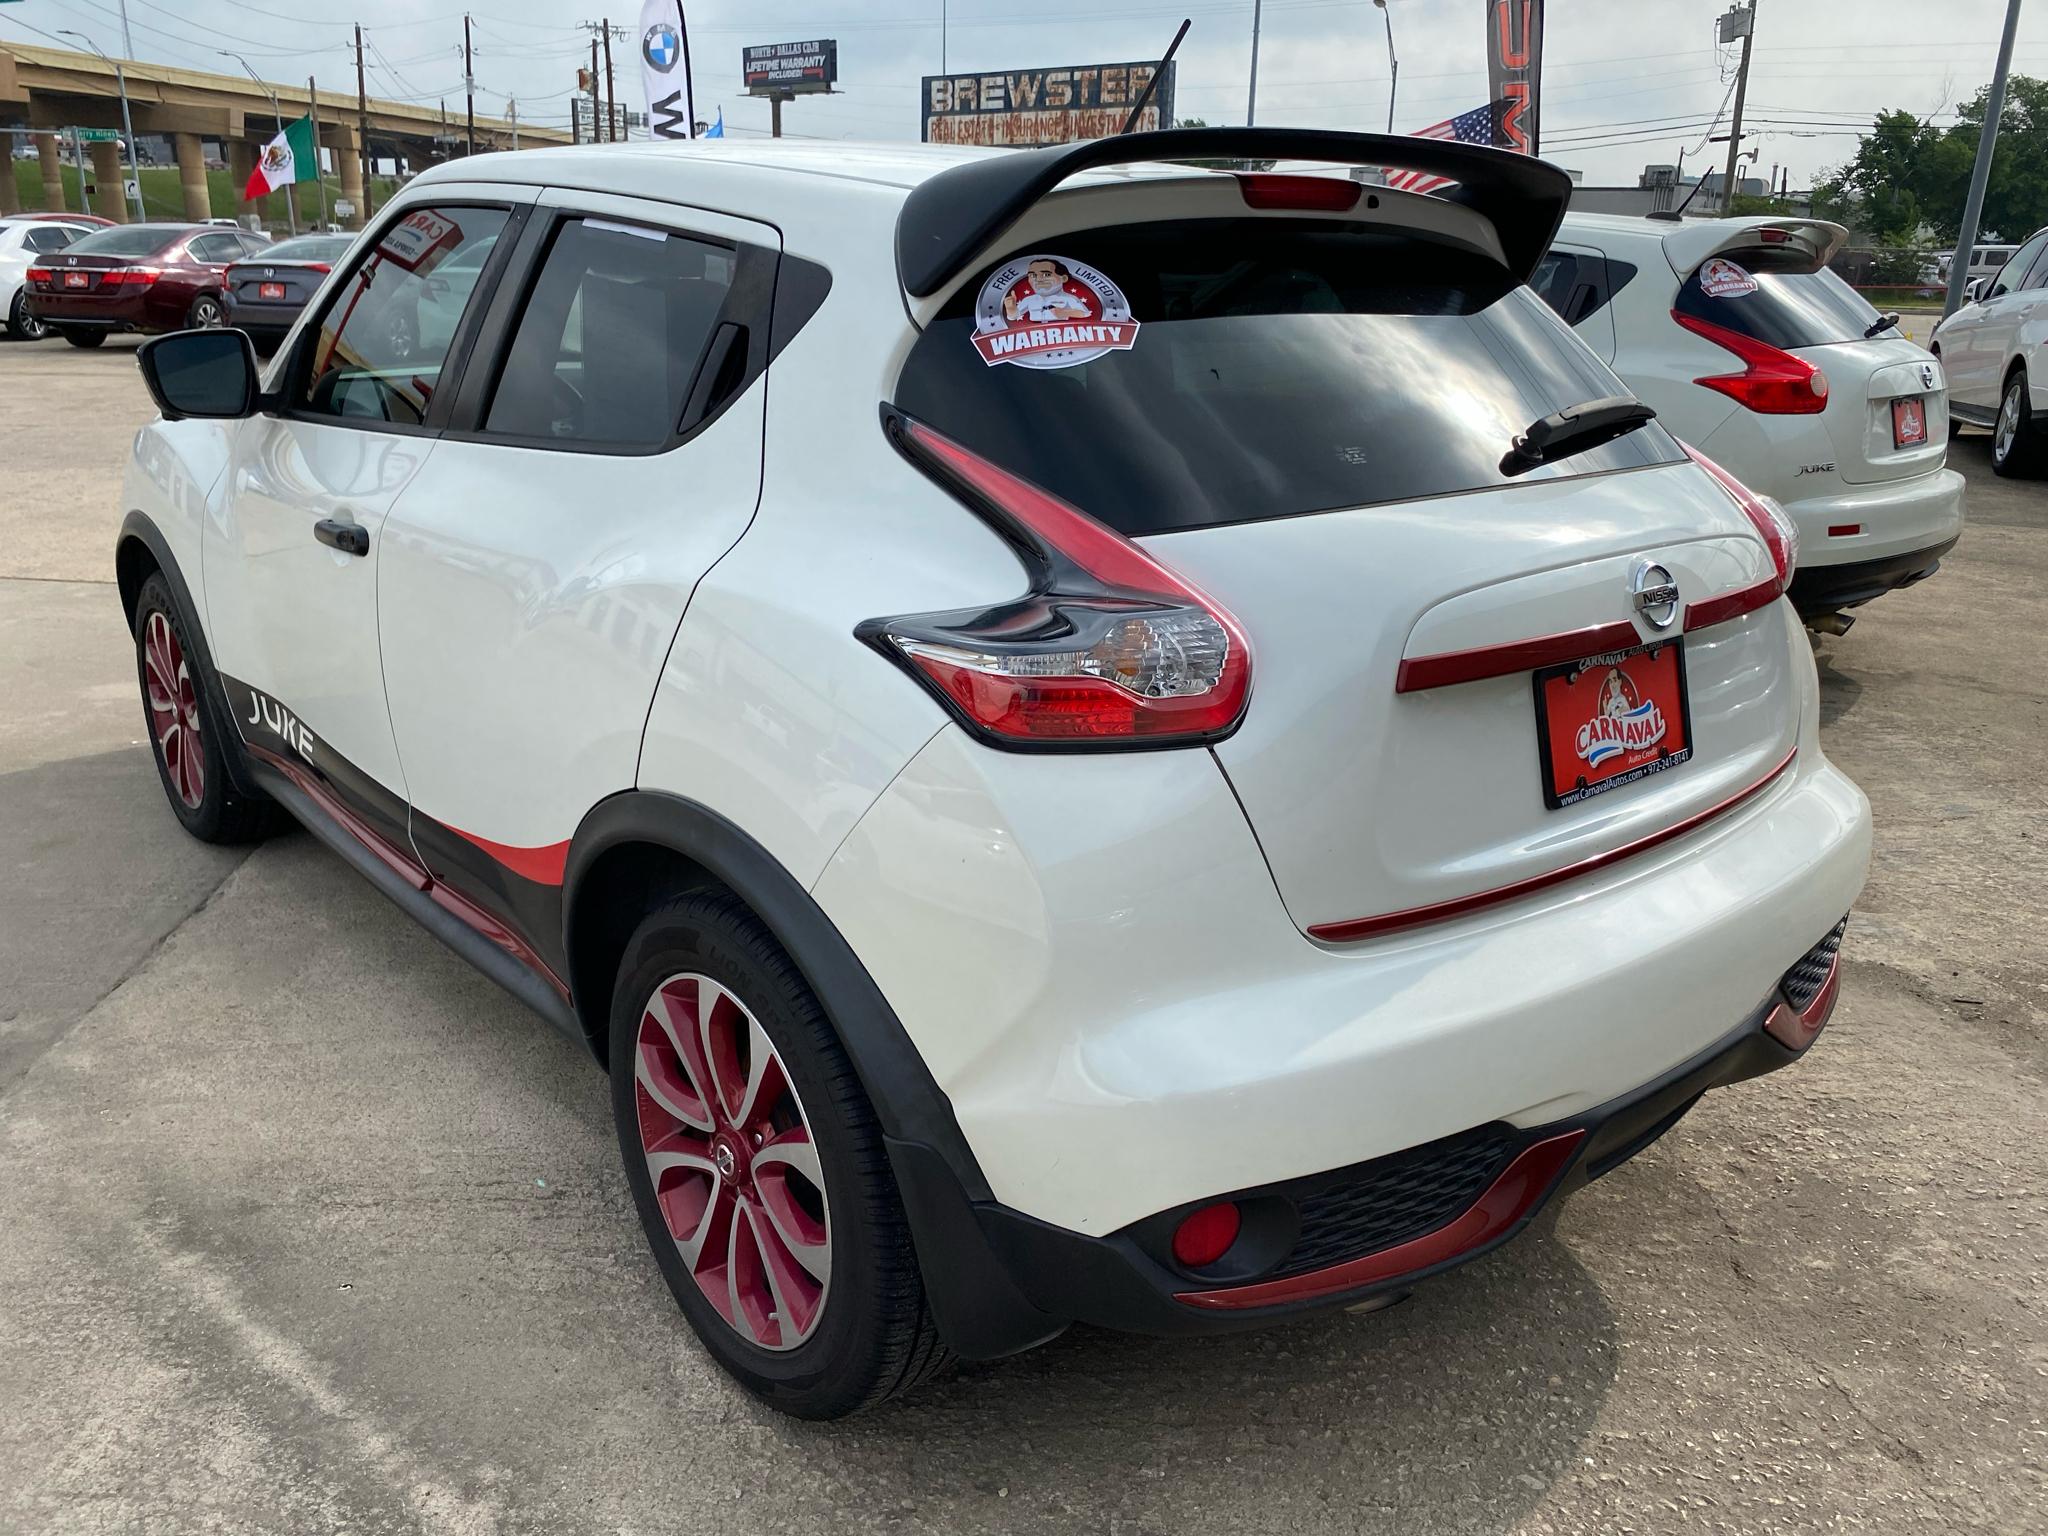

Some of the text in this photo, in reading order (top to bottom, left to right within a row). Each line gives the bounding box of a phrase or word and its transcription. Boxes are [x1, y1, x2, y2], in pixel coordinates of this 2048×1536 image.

[777, 43, 801, 56] DALLAS
[746, 55, 826, 72] LIFETIME WARRANTY
[768, 69, 803, 79] INCLUDED!
[931, 67, 1157, 112] BREWSTER
[932, 118, 955, 141] REAL
[992, 267, 1115, 297] FREE LIMITED
[990, 326, 1122, 356] WARRANTY
[1793, 462, 1836, 478] JUKE
[1579, 651, 1627, 670] CARNAVAL
[248, 690, 315, 767] JUKE
[1577, 711, 1663, 754] CARNAVAL
[1628, 746, 1658, 765] Auto Credit
[1561, 751, 1689, 807] www.CarnavalAutos.com 972-241-8141
